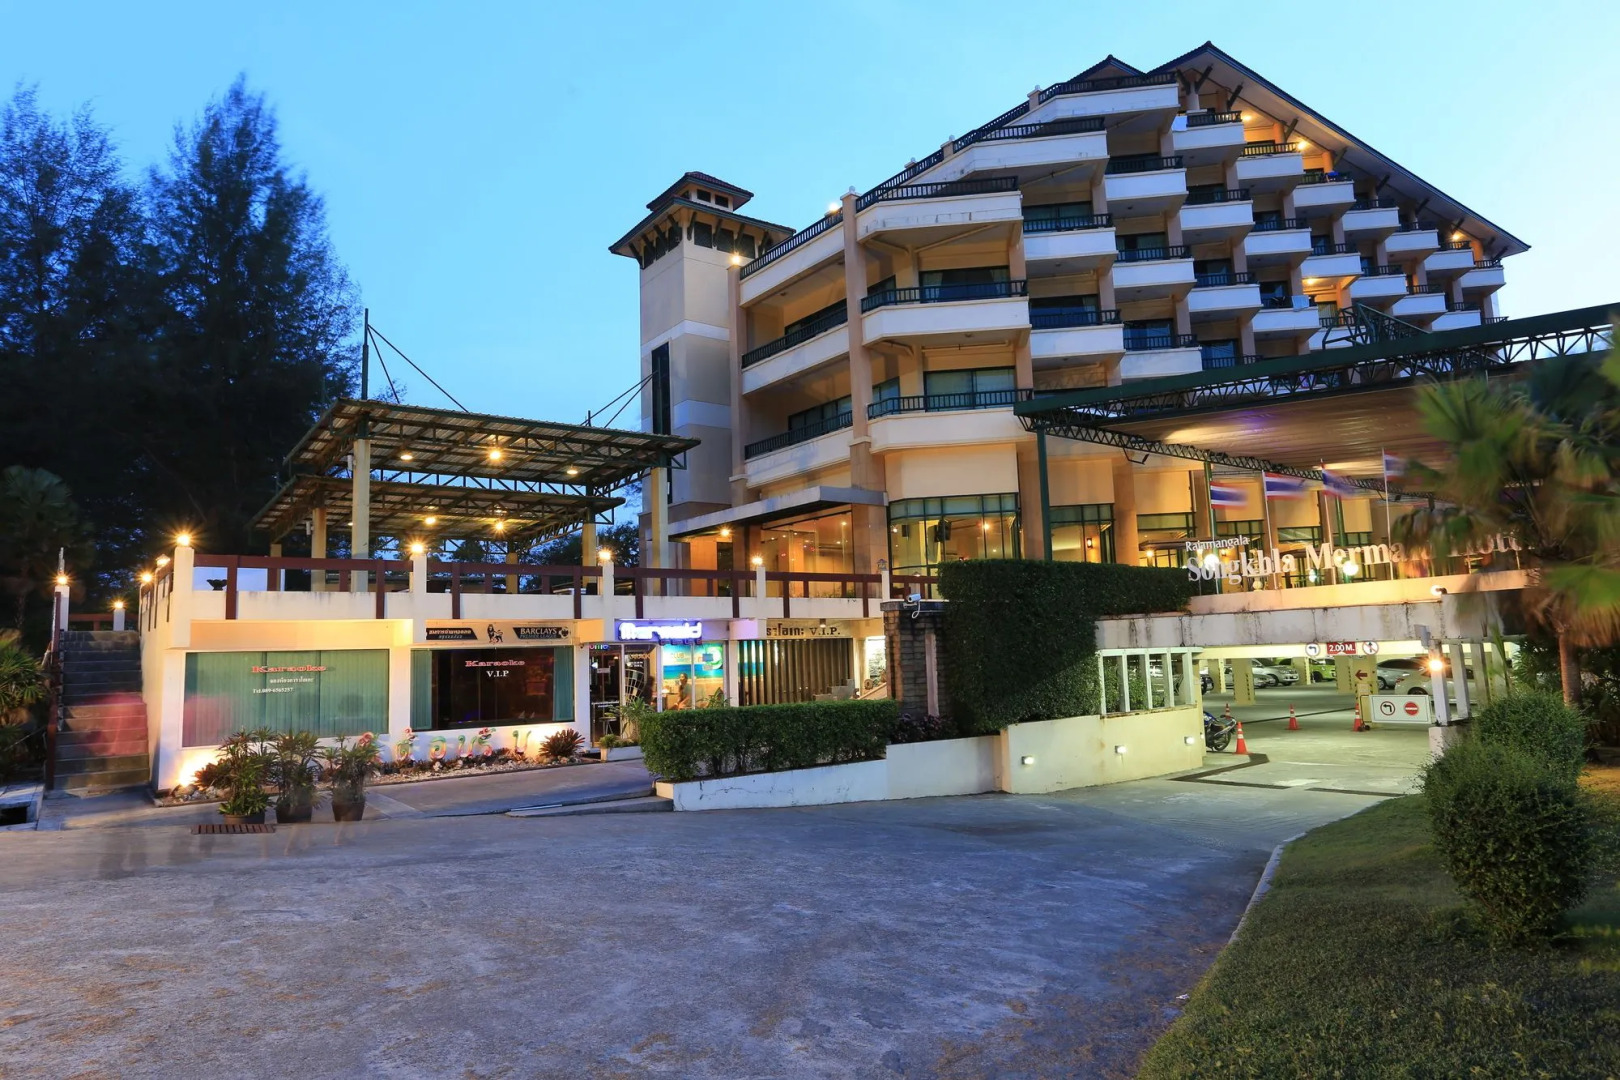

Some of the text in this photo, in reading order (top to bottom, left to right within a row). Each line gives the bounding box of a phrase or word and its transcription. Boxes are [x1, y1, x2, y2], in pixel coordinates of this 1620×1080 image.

[1188, 547, 1297, 585] Songkhla
[520, 627, 557, 635] BARCLAYS
[465, 659, 525, 667] Karaoke
[252, 665, 326, 674] Karaoke
[486, 670, 509, 678] V.I.P
